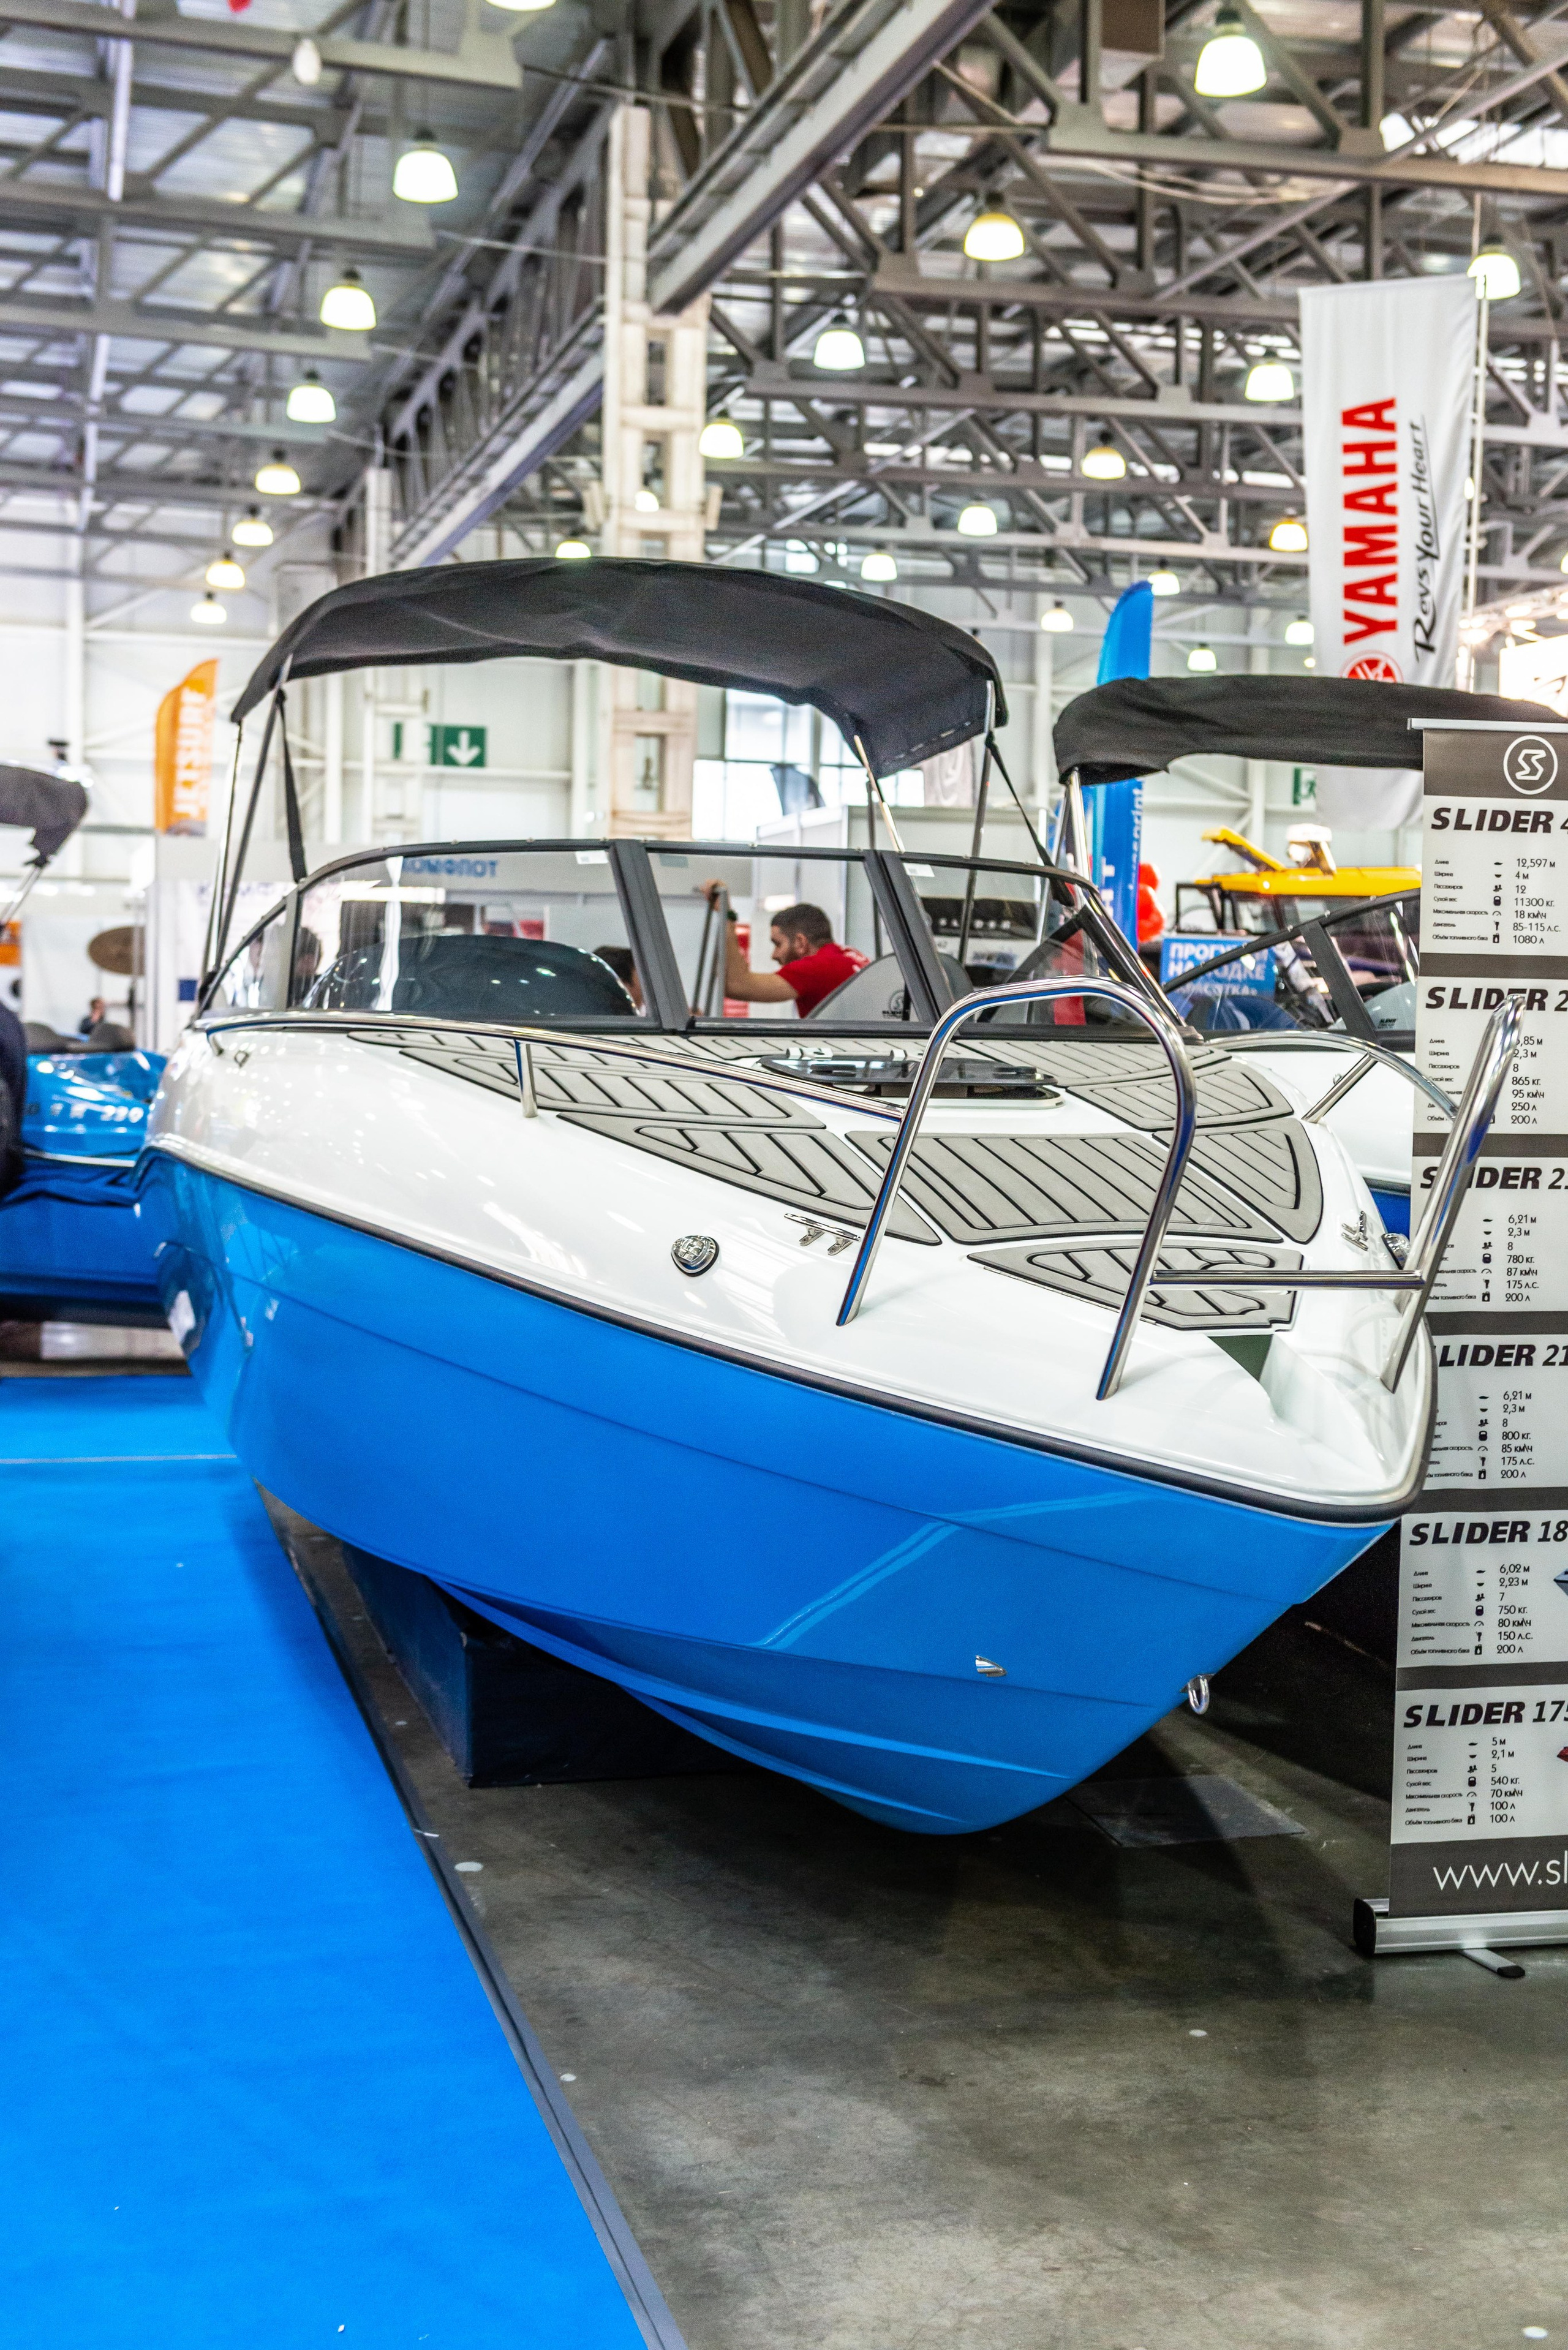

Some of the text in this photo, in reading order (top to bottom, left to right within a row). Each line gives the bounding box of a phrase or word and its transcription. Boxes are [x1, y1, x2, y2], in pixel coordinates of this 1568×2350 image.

[1341, 397, 1398, 647] YAMAHA
[1409, 421, 1440, 664] Revs Your Heart
[1431, 807, 1554, 834] SLIDER
[1517, 859, 1547, 869] 12,597
[1513, 923, 1545, 932] 85-115
[1513, 935, 1537, 944] 1080
[1208, 963, 1266, 980] ОДКЕ
[1425, 987, 1548, 1011] SLIDR
[1516, 1036, 1534, 1046] ,85
[1513, 1049, 1528, 1060] 2,3
[1513, 1064, 1518, 1072] 8
[1512, 1077, 1530, 1085] 865
[1512, 1090, 1524, 1098] 95
[1511, 1102, 1530, 1111] 250
[1511, 1115, 1530, 1124] 200
[1548, 1168, 1568, 1189] 2
[1508, 1215, 1528, 1225] 6,21
[1507, 1227, 1522, 1238] 2,3
[1507, 1241, 1513, 1251] 8
[1507, 1255, 1524, 1264] 780
[1507, 1267, 1518, 1276] 87
[1506, 1280, 1523, 1289] 175
[1506, 1293, 1523, 1301] 200
[1435, 1344, 1536, 1367] LIDER
[1503, 1391, 1522, 1402] 6,21
[1503, 1404, 1517, 1414] 2,3
[1502, 1418, 1508, 1427] 8
[1502, 1431, 1520, 1440] 800
[1502, 1444, 1512, 1453] 85
[1501, 1456, 1517, 1465] 175
[1501, 1469, 1518, 1478] 200
[1409, 1521, 1531, 1545] SLIDER
[1499, 1564, 1521, 1575] 6,02
[1499, 1577, 1519, 1588] 2,23
[1499, 1592, 1504, 1601] 7
[1498, 1605, 1516, 1614] 750
[1498, 1618, 1510, 1627] 80
[1498, 1631, 1515, 1640] 150
[1497, 1644, 1515, 1654] 200
[1403, 1700, 1568, 1728] SLIDER 17
[1491, 1737, 1497, 1746] 5
[1491, 1749, 1504, 1760] 2,1
[1491, 1764, 1496, 1772] 5
[1491, 1776, 1509, 1785] 540
[1491, 1788, 1502, 1798] 70
[1490, 1801, 1508, 1810] 100
[1490, 1813, 1508, 1823] 100
